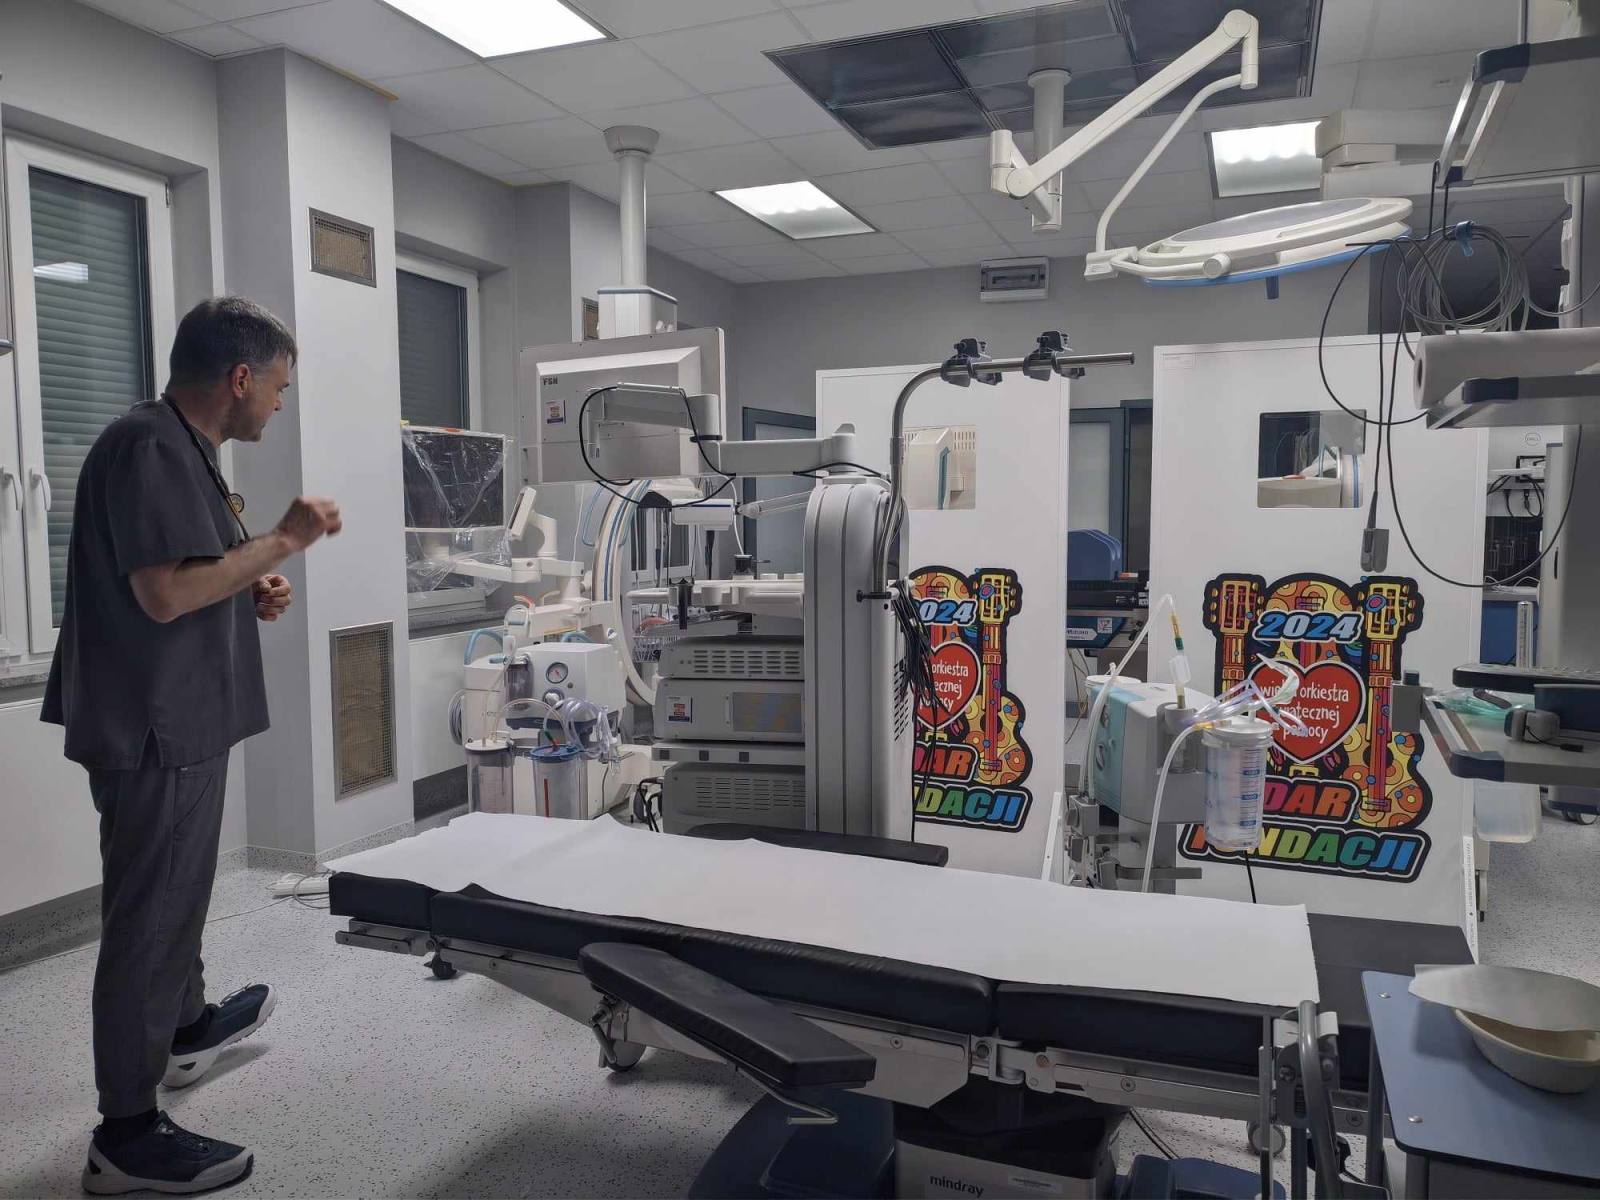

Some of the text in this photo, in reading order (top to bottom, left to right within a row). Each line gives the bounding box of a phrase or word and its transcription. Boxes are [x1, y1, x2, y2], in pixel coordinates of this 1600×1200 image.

[914, 600, 974, 622] 024
[1257, 612, 1357, 639] 2024
[931, 659, 969, 677] orkiestra
[1300, 681, 1349, 703] orkiestra
[1279, 700, 1339, 729] tecznej
[1283, 721, 1328, 744] pocy
[913, 786, 1022, 822] DACJI
[1263, 782, 1350, 817] DAR
[1190, 823, 1417, 871] NDACJI
[930, 1175, 984, 1198] mindray
